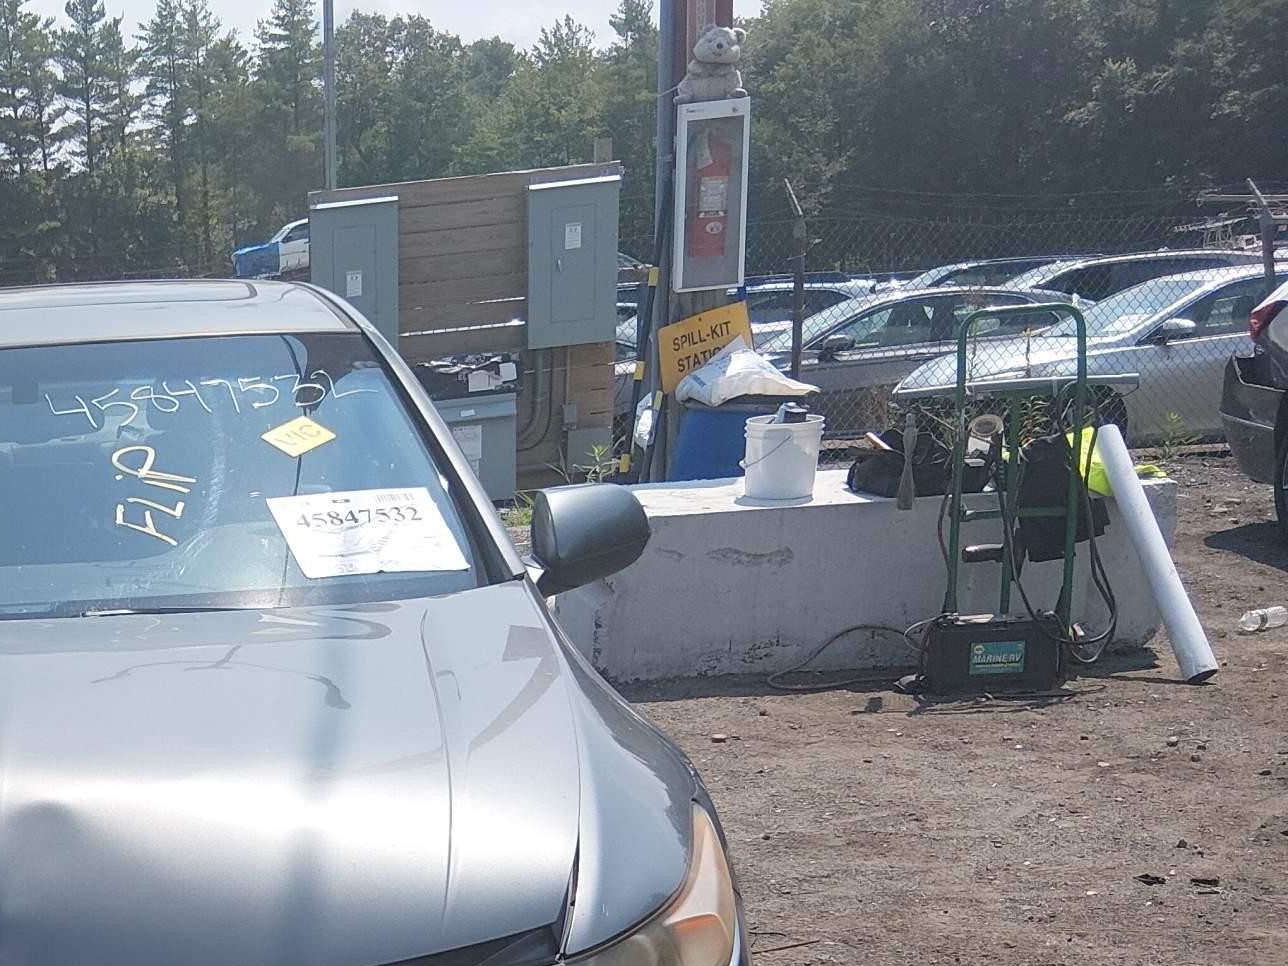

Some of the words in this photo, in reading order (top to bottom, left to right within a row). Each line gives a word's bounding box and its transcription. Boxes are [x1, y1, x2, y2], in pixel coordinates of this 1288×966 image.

[672, 321, 731, 352] SPILL-KIT
[677, 344, 727, 373] STATIO
[45, 370, 378, 429] 45847532
[296, 506, 423, 528] 45847532
